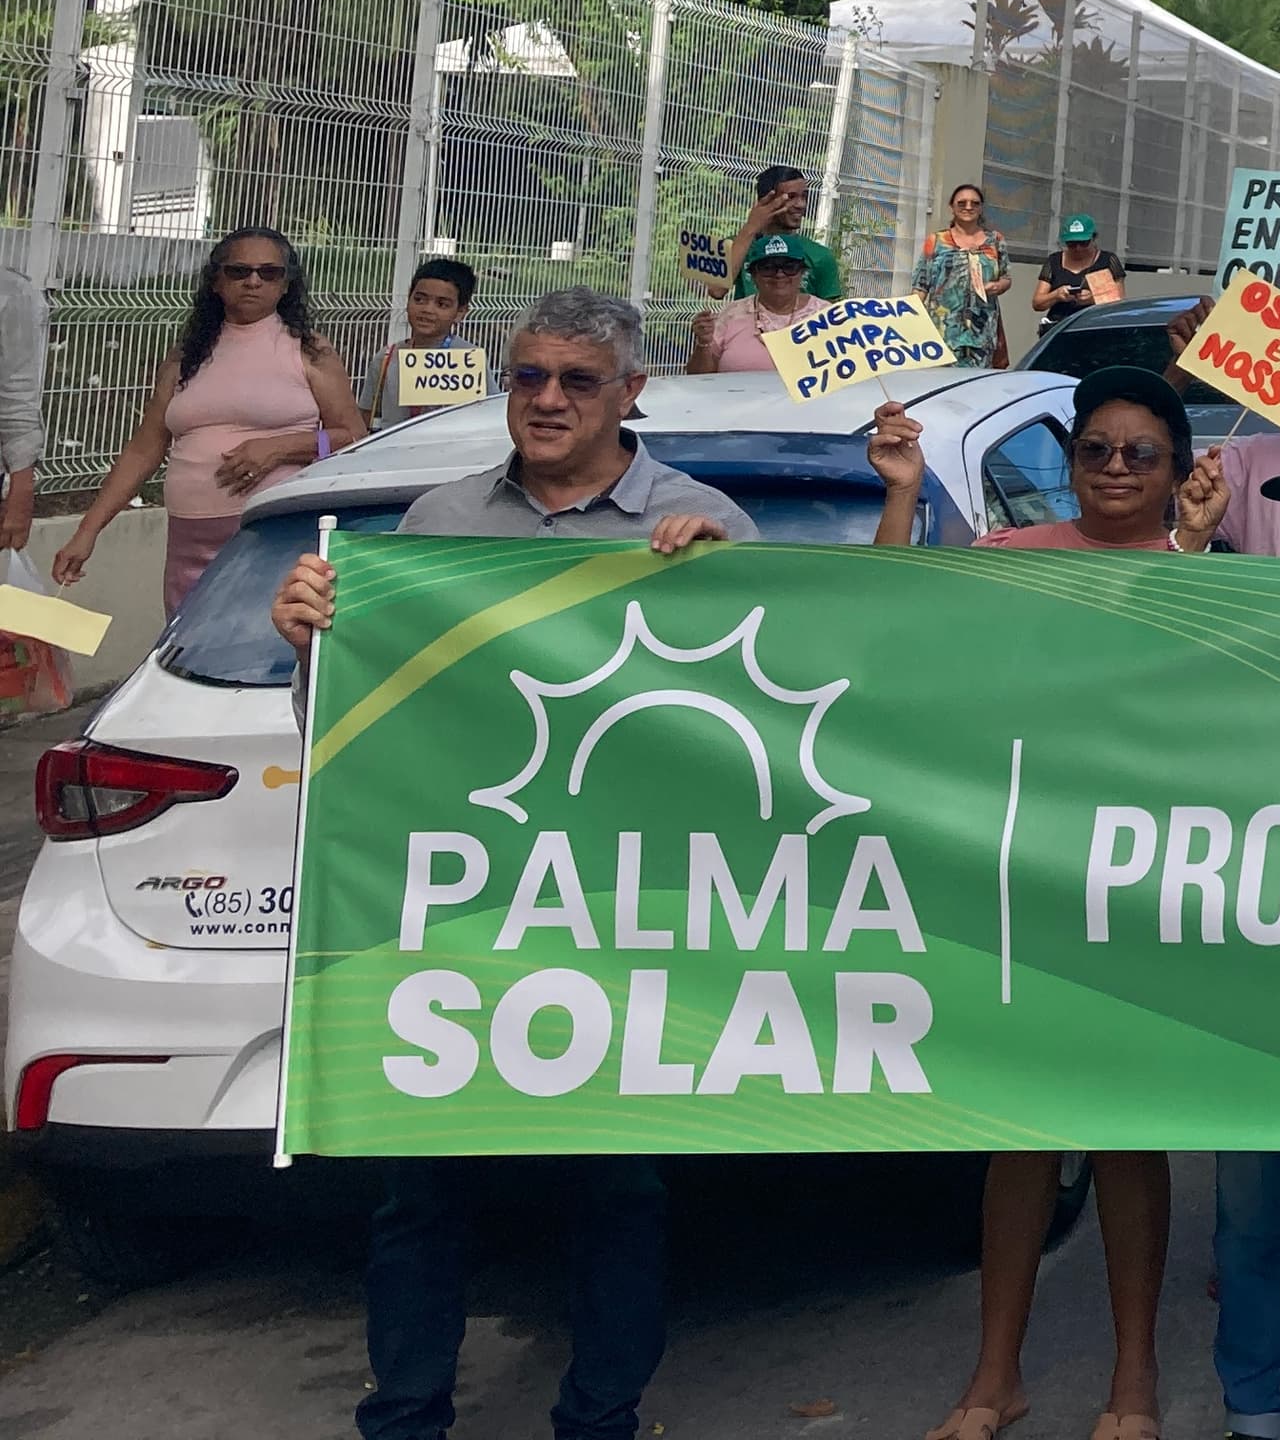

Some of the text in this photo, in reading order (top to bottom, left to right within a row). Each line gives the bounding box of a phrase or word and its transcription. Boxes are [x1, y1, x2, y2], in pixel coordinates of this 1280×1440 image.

[686, 253, 728, 278] NOSSO
[790, 299, 919, 345] ENERGIA
[405, 348, 477, 369] O SOL É
[807, 324, 909, 369] LIMPA
[865, 341, 944, 372] POVO
[415, 371, 483, 395] NOSSO!
[136, 875, 228, 891] ARGO
[399, 830, 927, 953] PALMA
[204, 886, 293, 916] (85) 30
[190, 921, 291, 935] www.conn
[382, 966, 935, 1098] SOLAR
